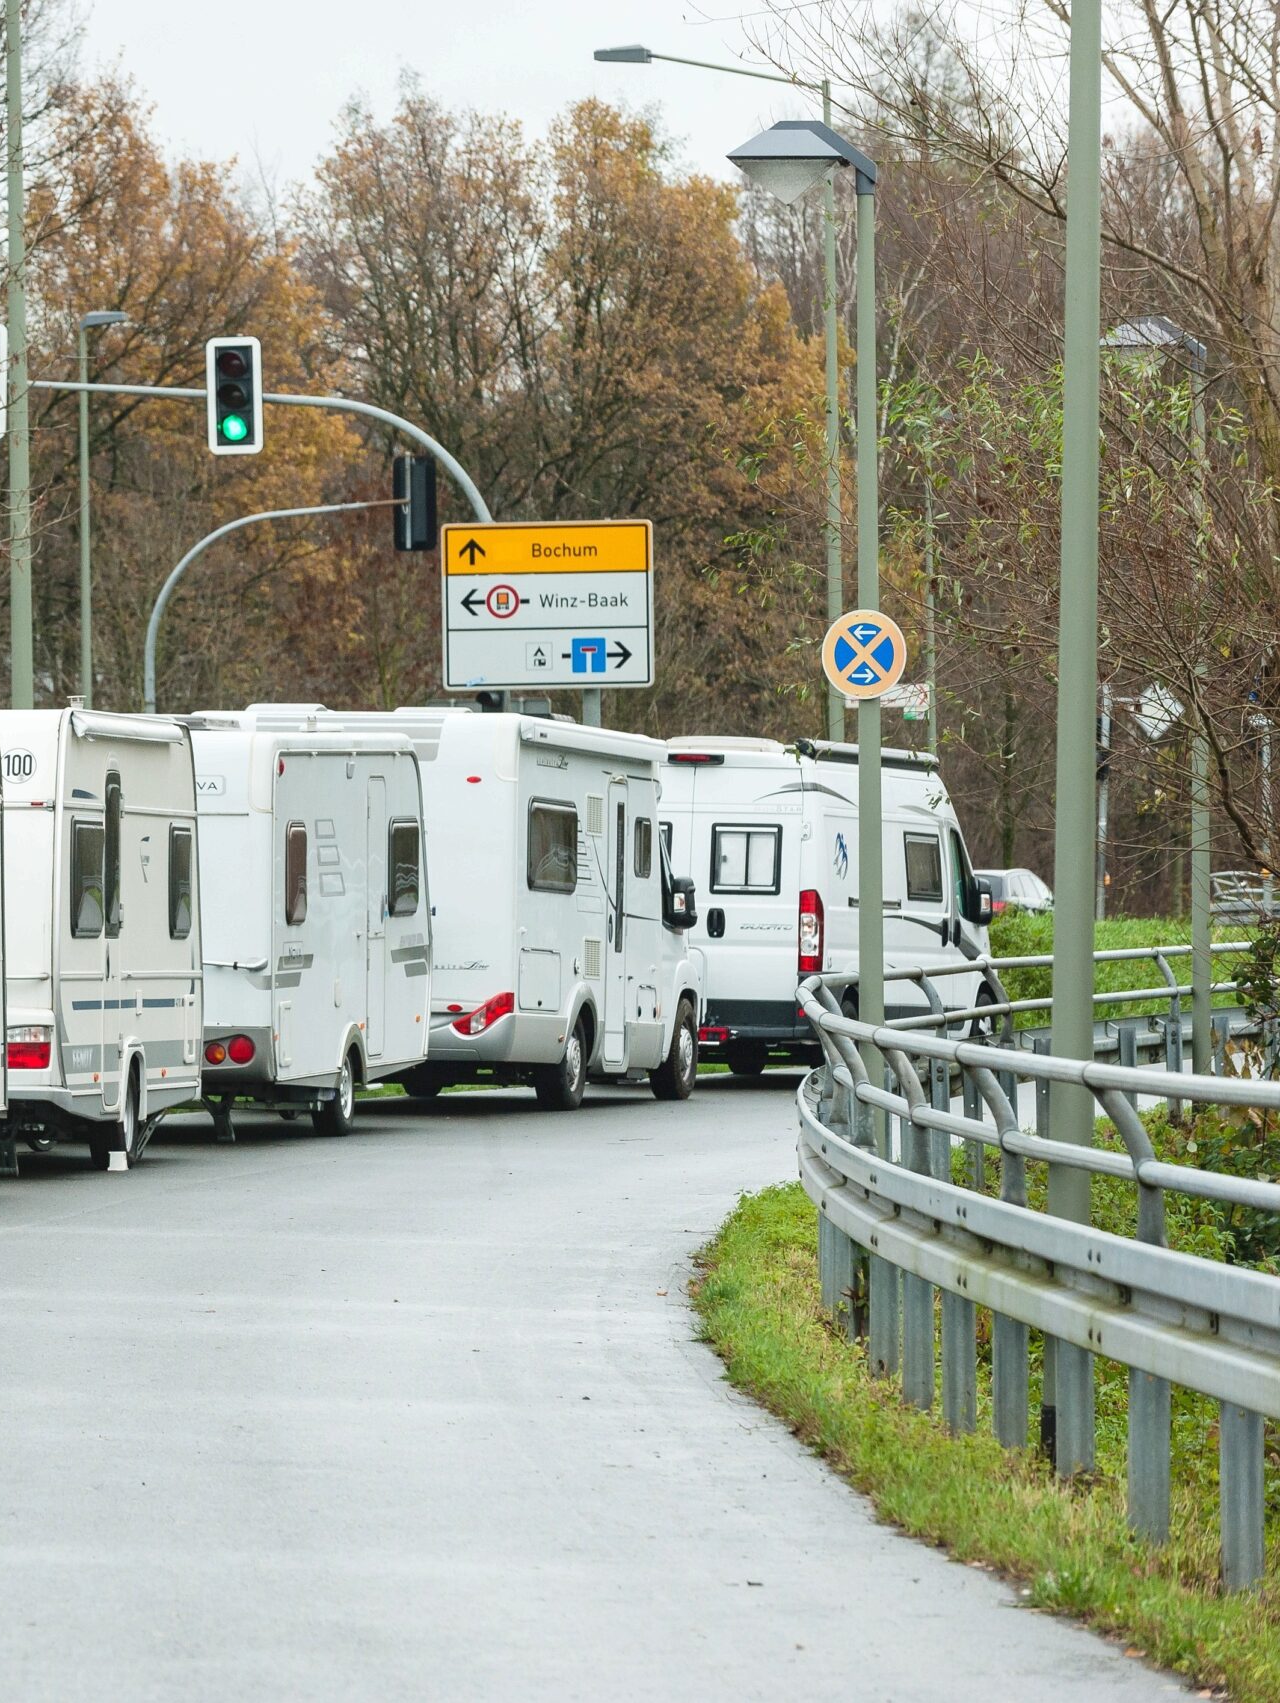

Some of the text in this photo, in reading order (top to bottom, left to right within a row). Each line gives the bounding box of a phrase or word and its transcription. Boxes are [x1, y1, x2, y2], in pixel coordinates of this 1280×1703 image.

[531, 543, 598, 558] Bochum
[539, 592, 629, 608] Winz-Baak
[4, 754, 33, 777] 100
